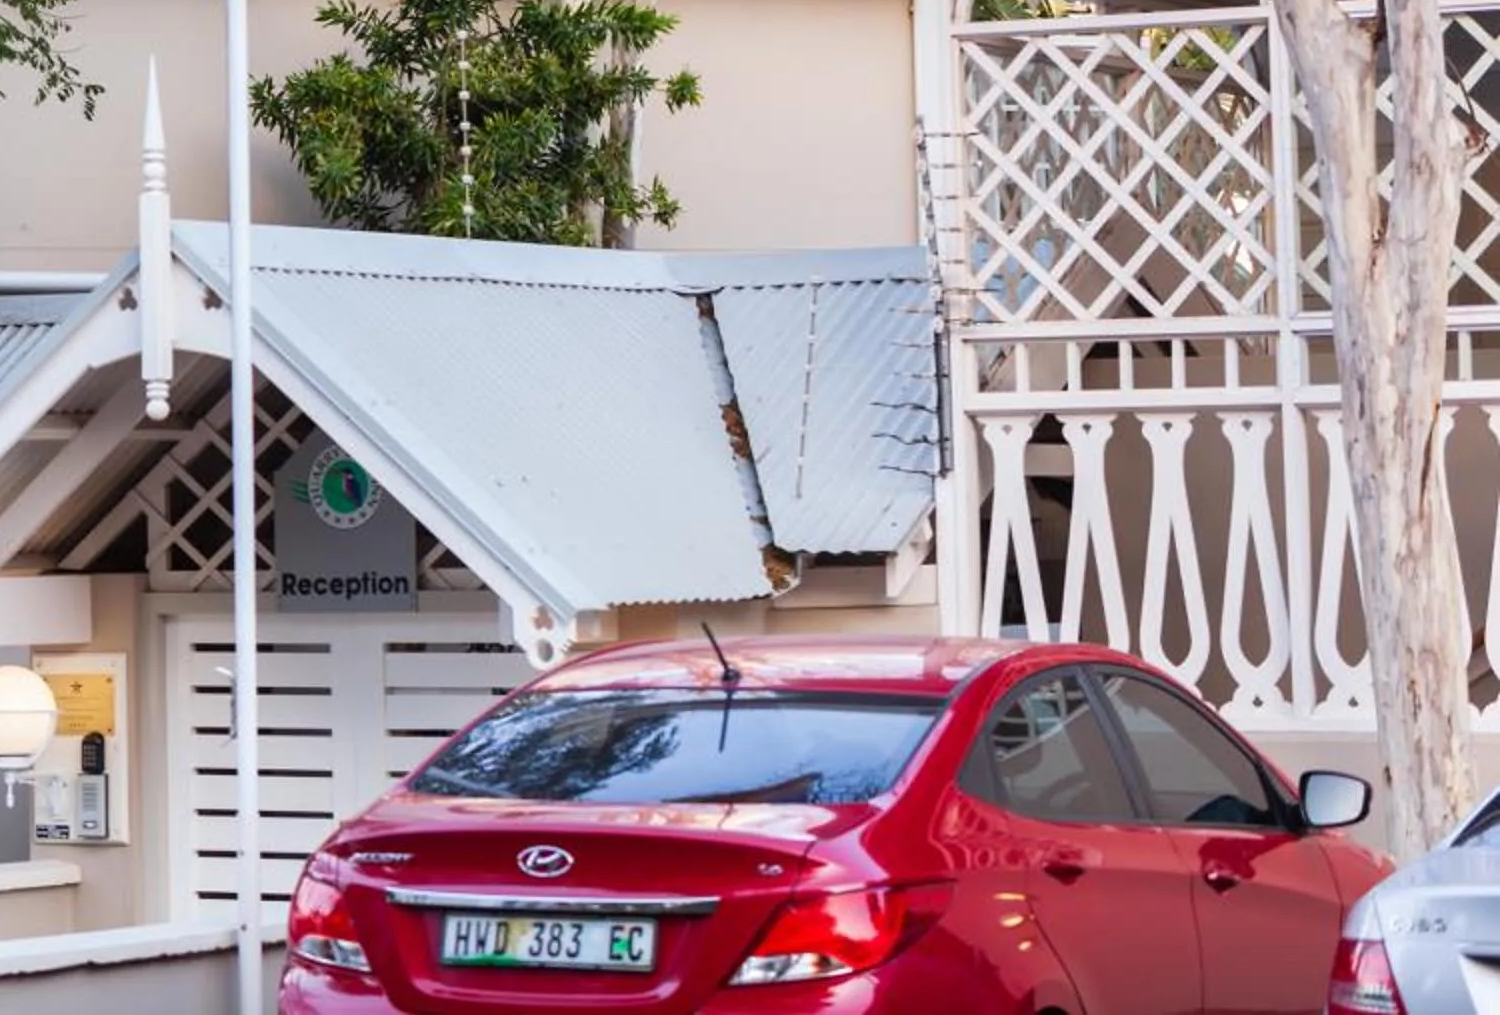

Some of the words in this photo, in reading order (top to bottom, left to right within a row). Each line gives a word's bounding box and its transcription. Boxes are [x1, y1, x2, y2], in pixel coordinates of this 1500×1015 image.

[281, 572, 409, 600] Reception
[453, 920, 510, 956] HWD
[528, 922, 582, 960] 383
[607, 925, 644, 962] EC
